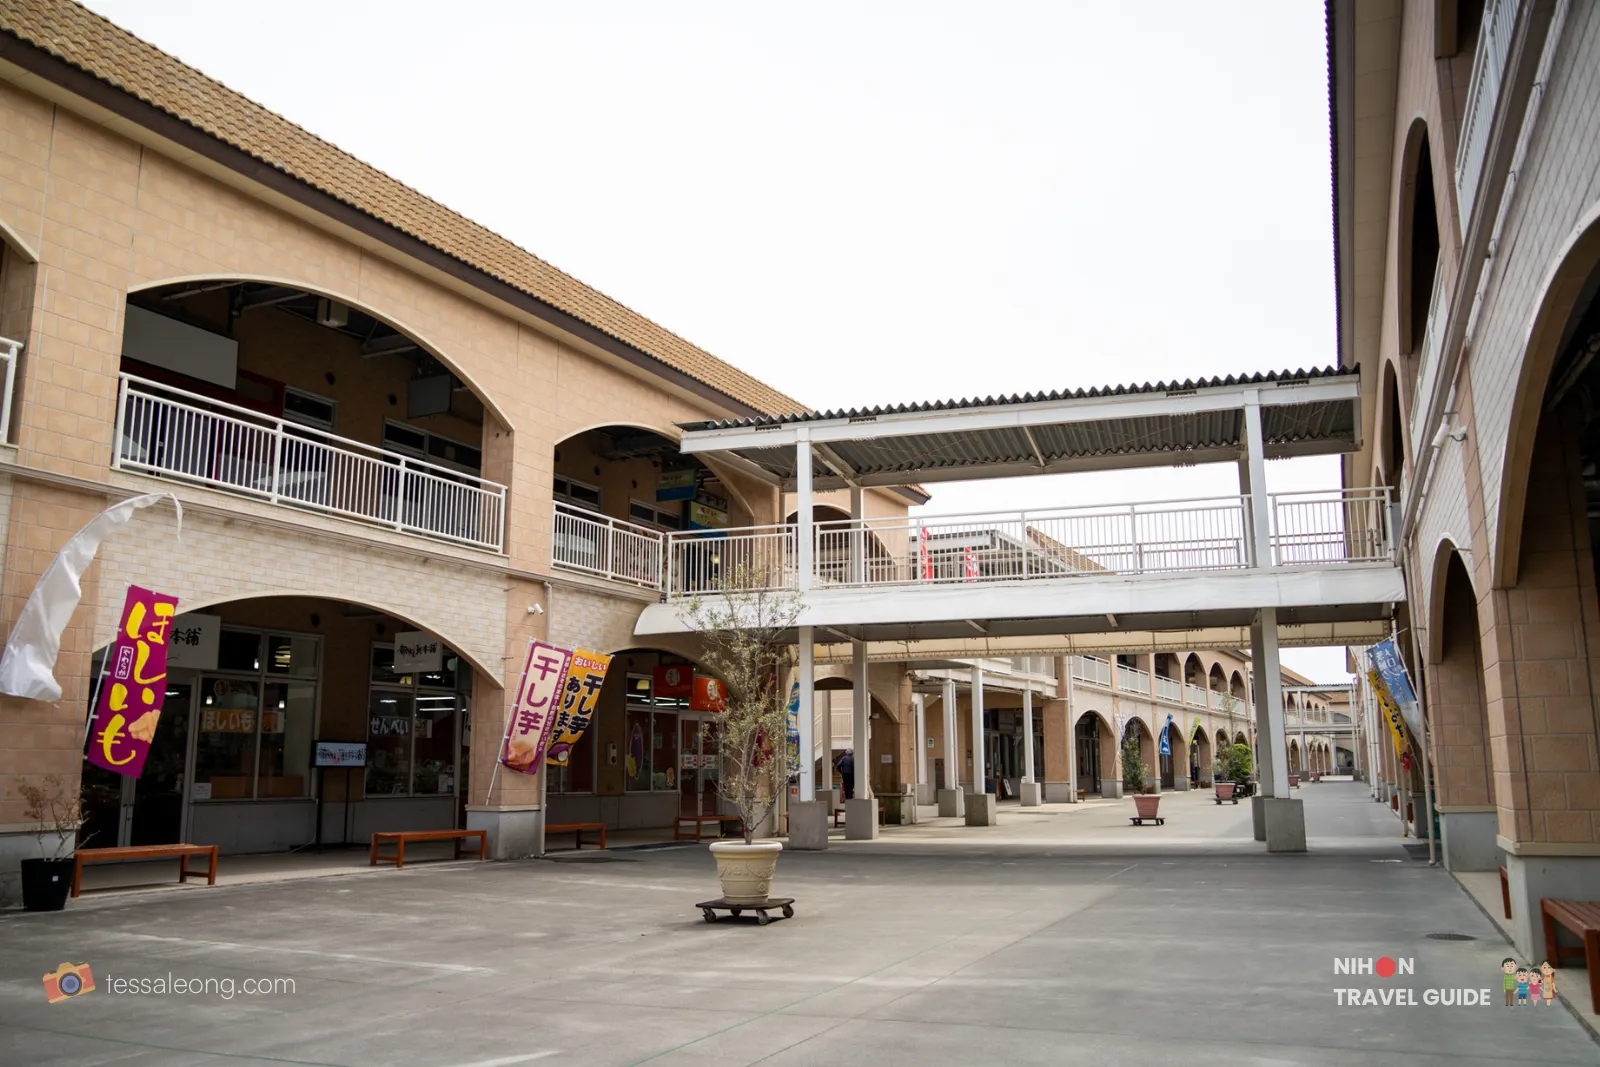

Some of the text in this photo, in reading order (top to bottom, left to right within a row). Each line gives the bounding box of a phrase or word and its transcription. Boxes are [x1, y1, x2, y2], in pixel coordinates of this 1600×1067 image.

[97, 601, 175, 765] ほしいも
[574, 656, 607, 671] おいしい
[203, 710, 253, 731] ほしいも
[370, 717, 409, 735] せんべい
[518, 655, 560, 735] 干し芋
[551, 676, 581, 743] あります
[567, 673, 604, 735] 干し芋
